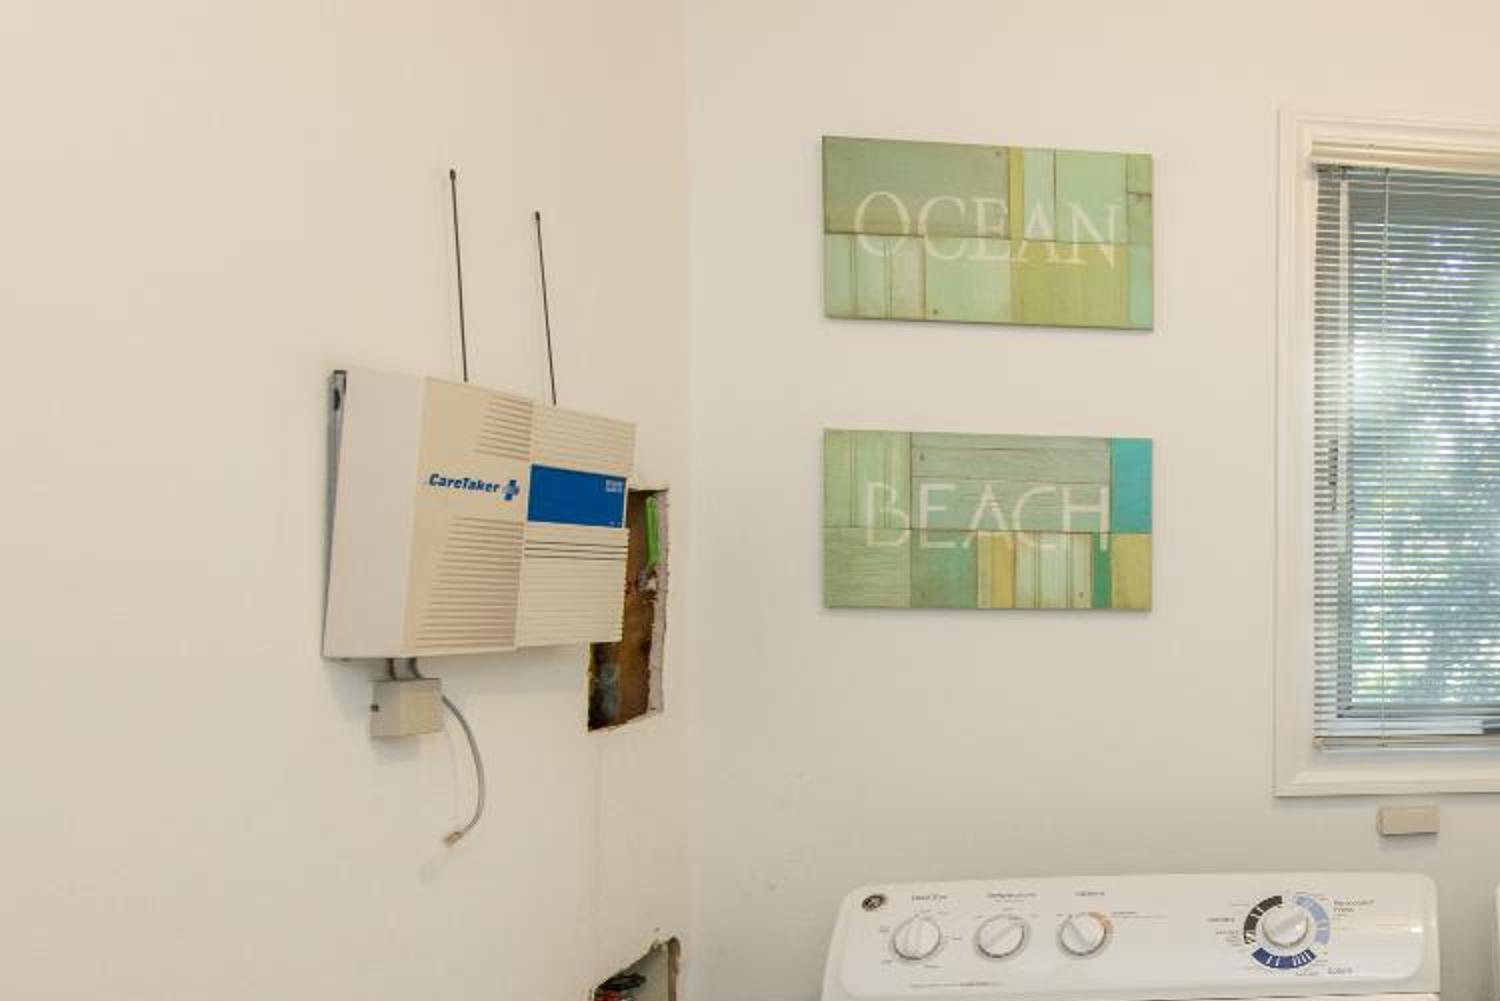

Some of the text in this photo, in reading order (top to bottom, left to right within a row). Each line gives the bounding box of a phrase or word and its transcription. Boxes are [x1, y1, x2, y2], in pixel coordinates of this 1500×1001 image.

[854, 190, 1123, 269] OCEAN
[429, 472, 500, 493] CareTaker
[865, 480, 1110, 551] BEACH
